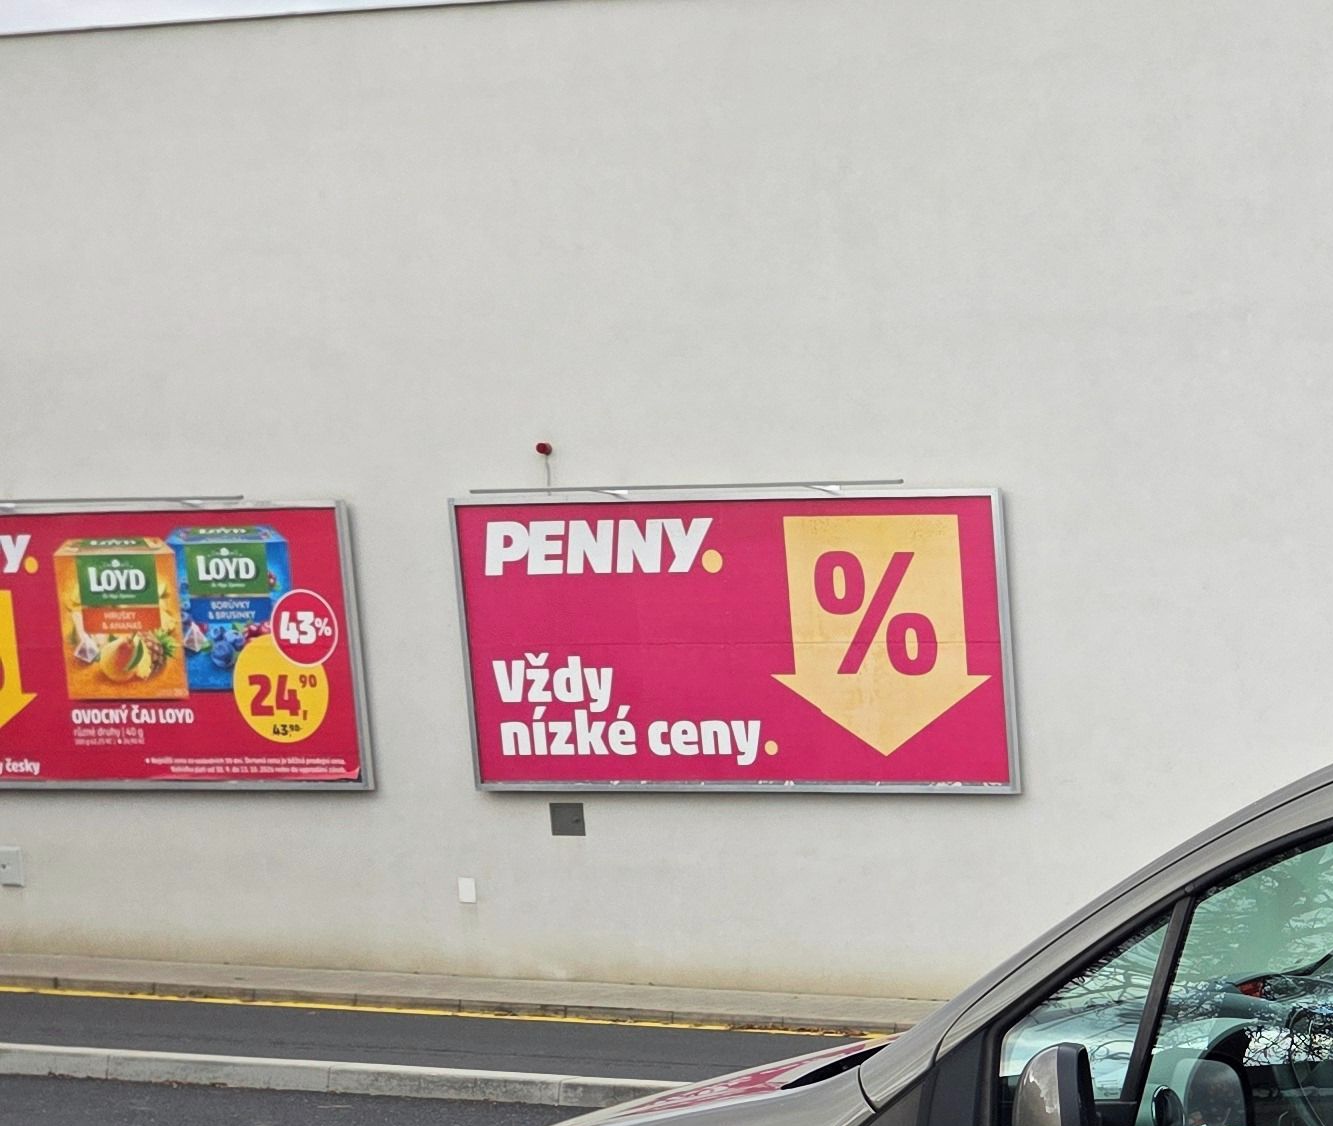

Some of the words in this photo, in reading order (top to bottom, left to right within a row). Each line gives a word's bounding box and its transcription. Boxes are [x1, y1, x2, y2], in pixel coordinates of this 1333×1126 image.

[87, 566, 146, 593] LOYD
[195, 555, 256, 581] LOYD
[280, 611, 332, 645] 43%
[492, 652, 613, 713] Vždy
[71, 704, 129, 724] OVOCNÝ
[131, 704, 157, 724] ČAJ
[158, 708, 195, 724] LOYD
[499, 705, 637, 756] nízké
[648, 719, 779, 767] ceny.
[6, 758, 40, 775] česky
